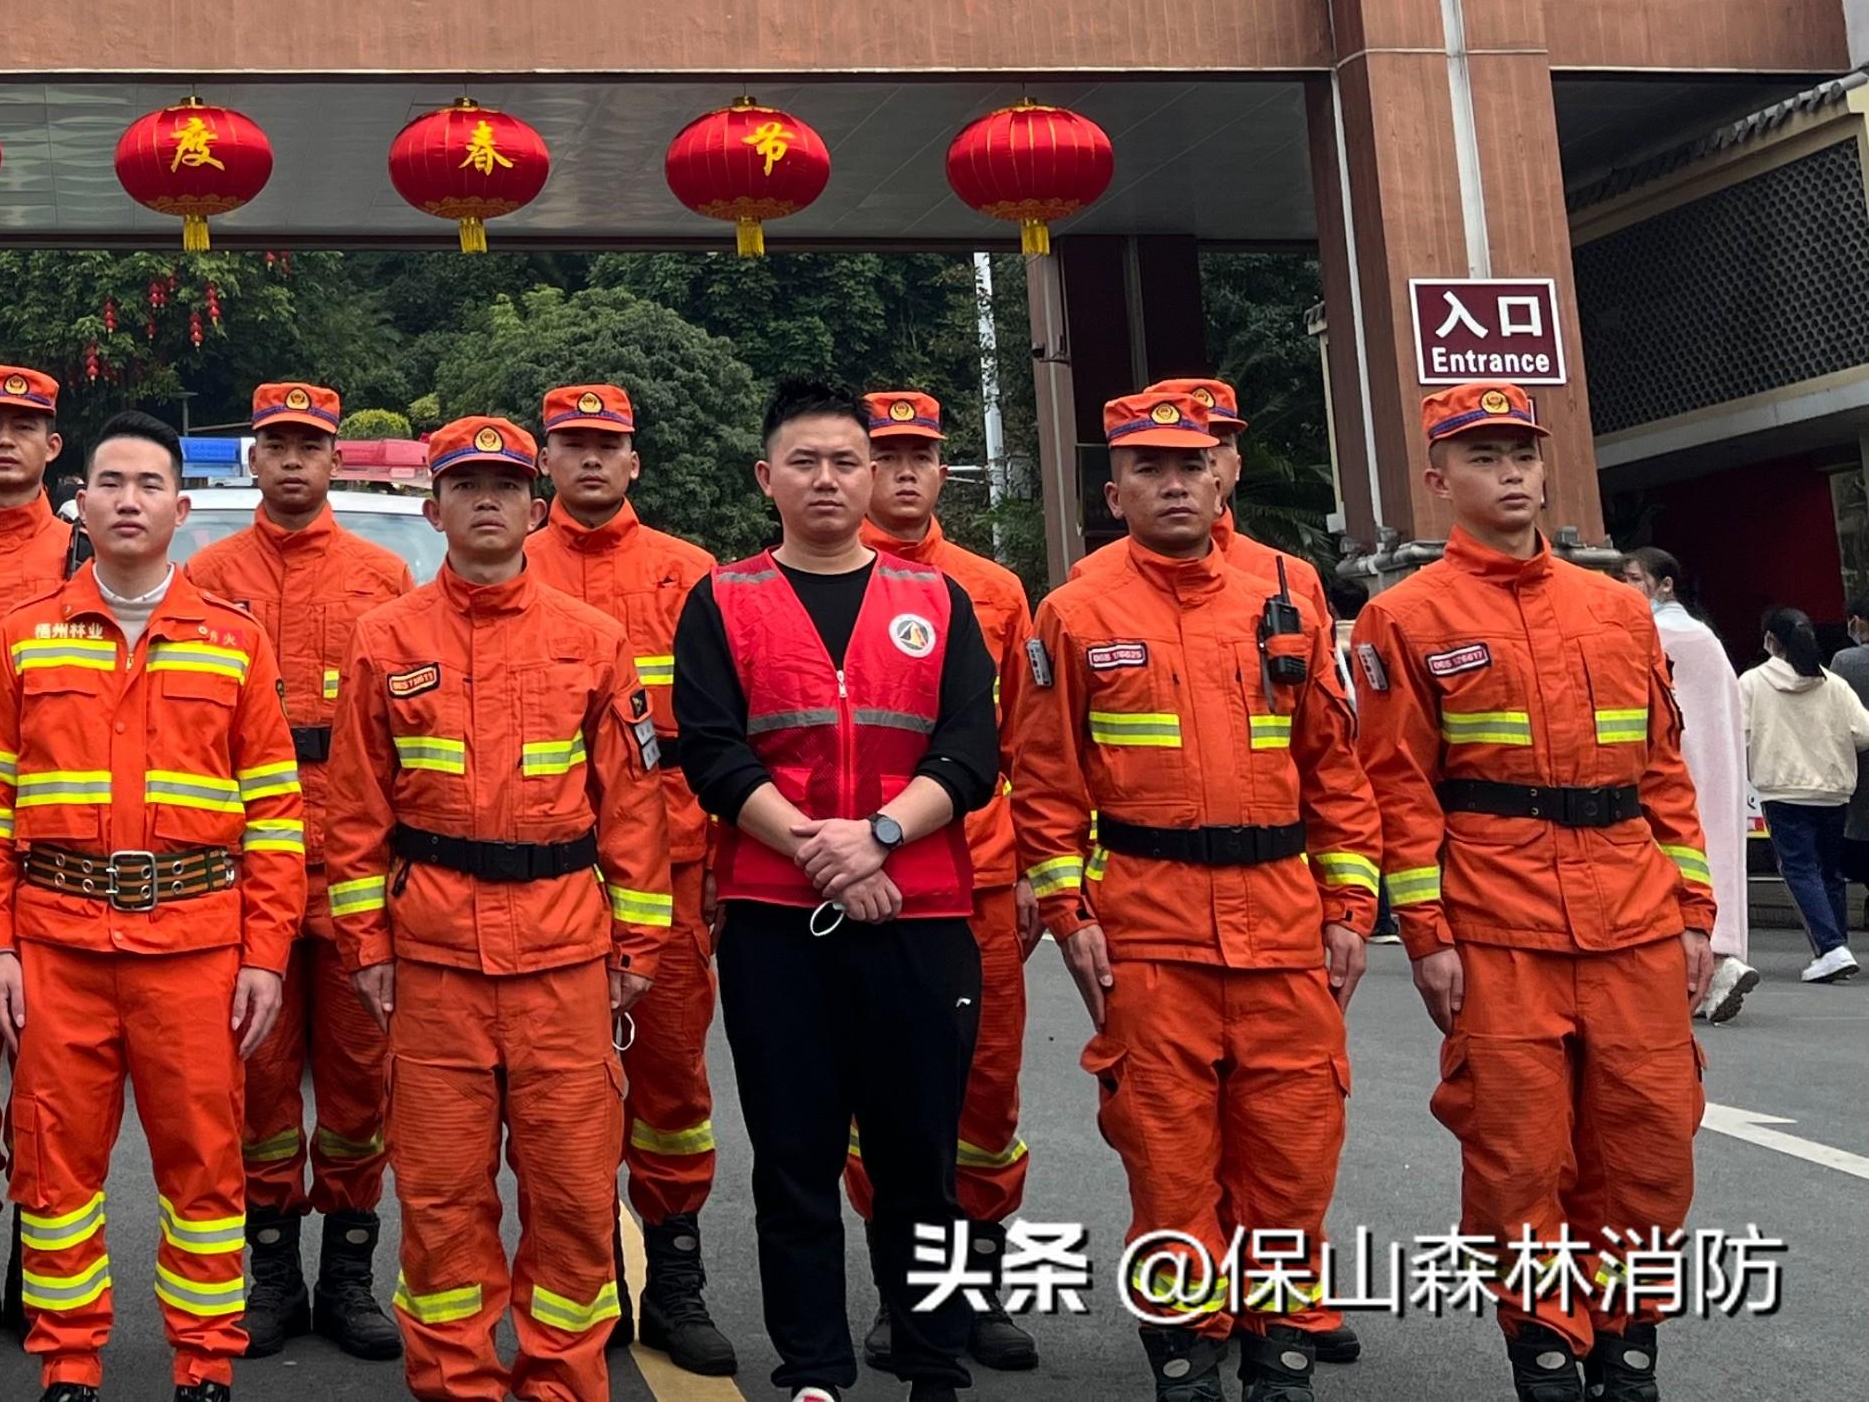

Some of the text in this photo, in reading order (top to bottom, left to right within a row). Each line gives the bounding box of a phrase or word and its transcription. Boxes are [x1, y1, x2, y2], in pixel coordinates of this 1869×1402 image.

[170, 117, 227, 174] 度
[457, 120, 514, 176] 春
[742, 121, 795, 177] 节
[1435, 290, 1543, 339] 入口
[1432, 346, 1550, 373] Entrance
[34, 621, 104, 640] 梧州林业
